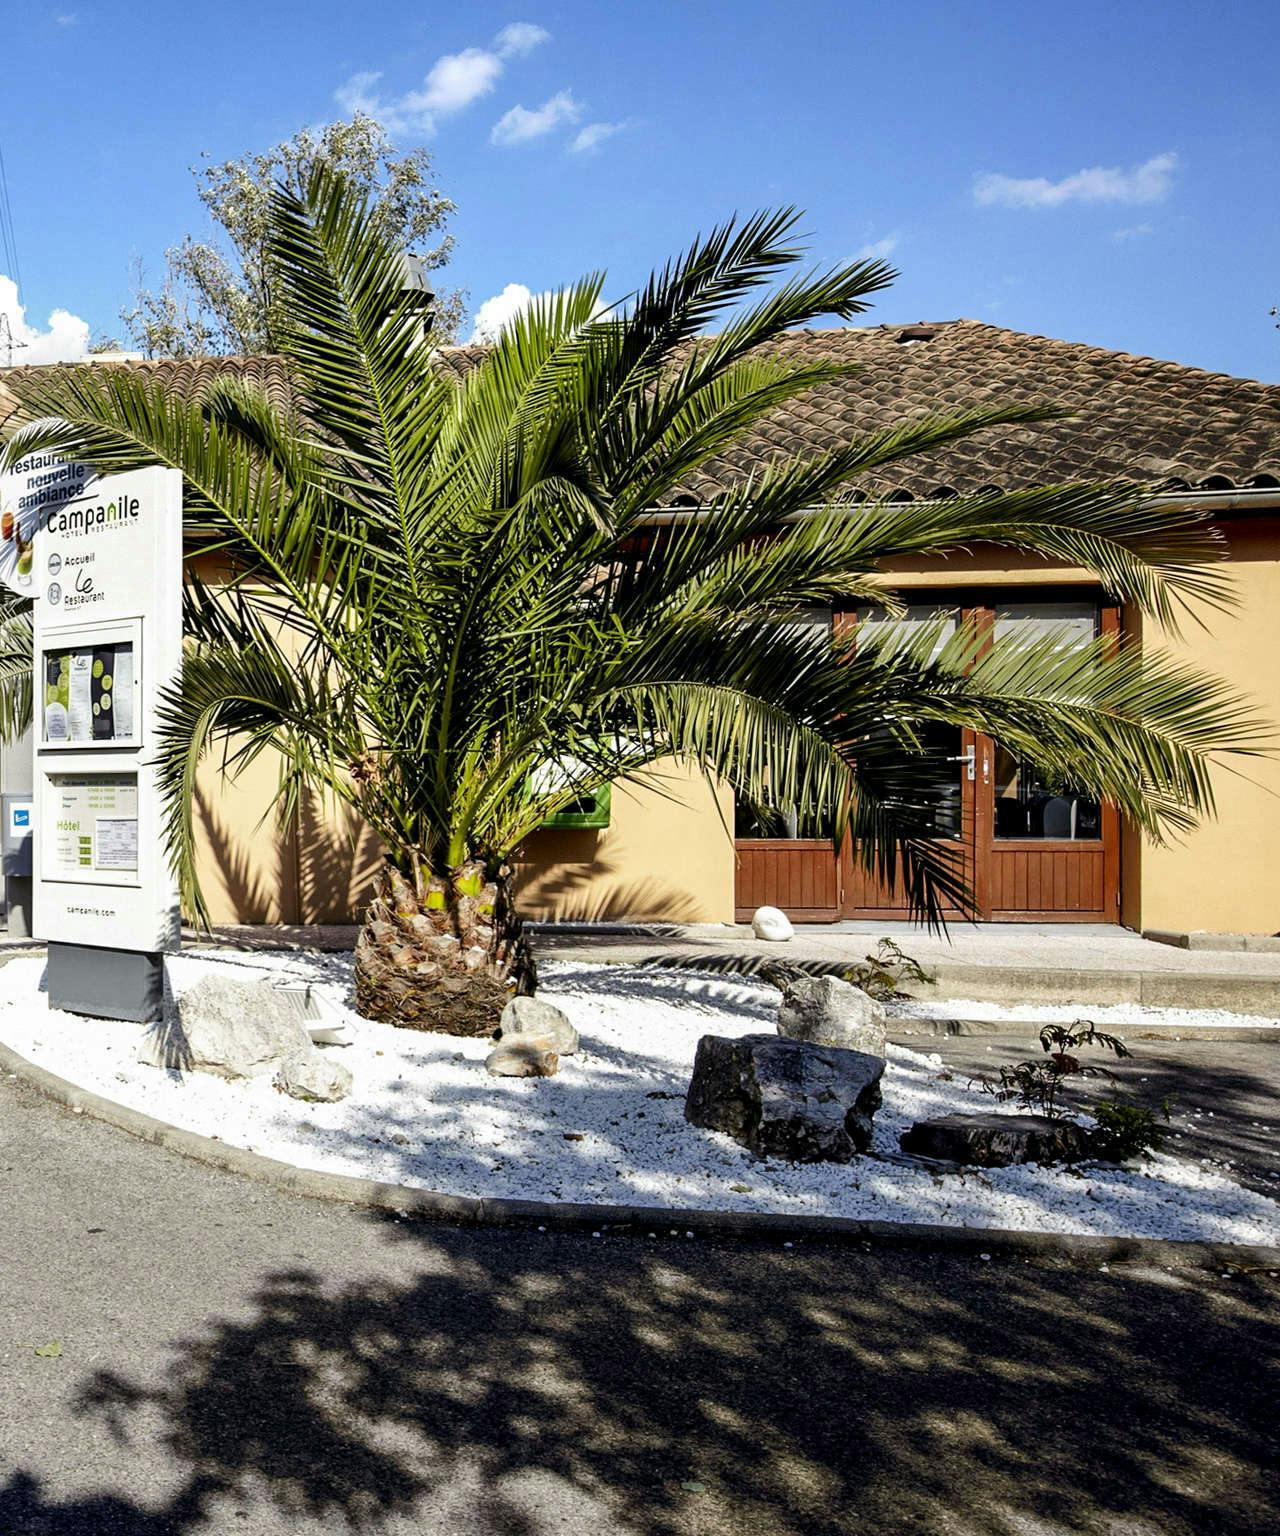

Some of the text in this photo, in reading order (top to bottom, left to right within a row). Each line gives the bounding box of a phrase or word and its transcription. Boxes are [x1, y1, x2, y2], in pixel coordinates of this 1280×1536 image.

[27, 463, 85, 489] nouvelle
[18, 483, 85, 508] ambiance
[47, 495, 140, 535] Campanile
[64, 552, 96, 566] Accueil
[64, 592, 105, 606] Restaurant
